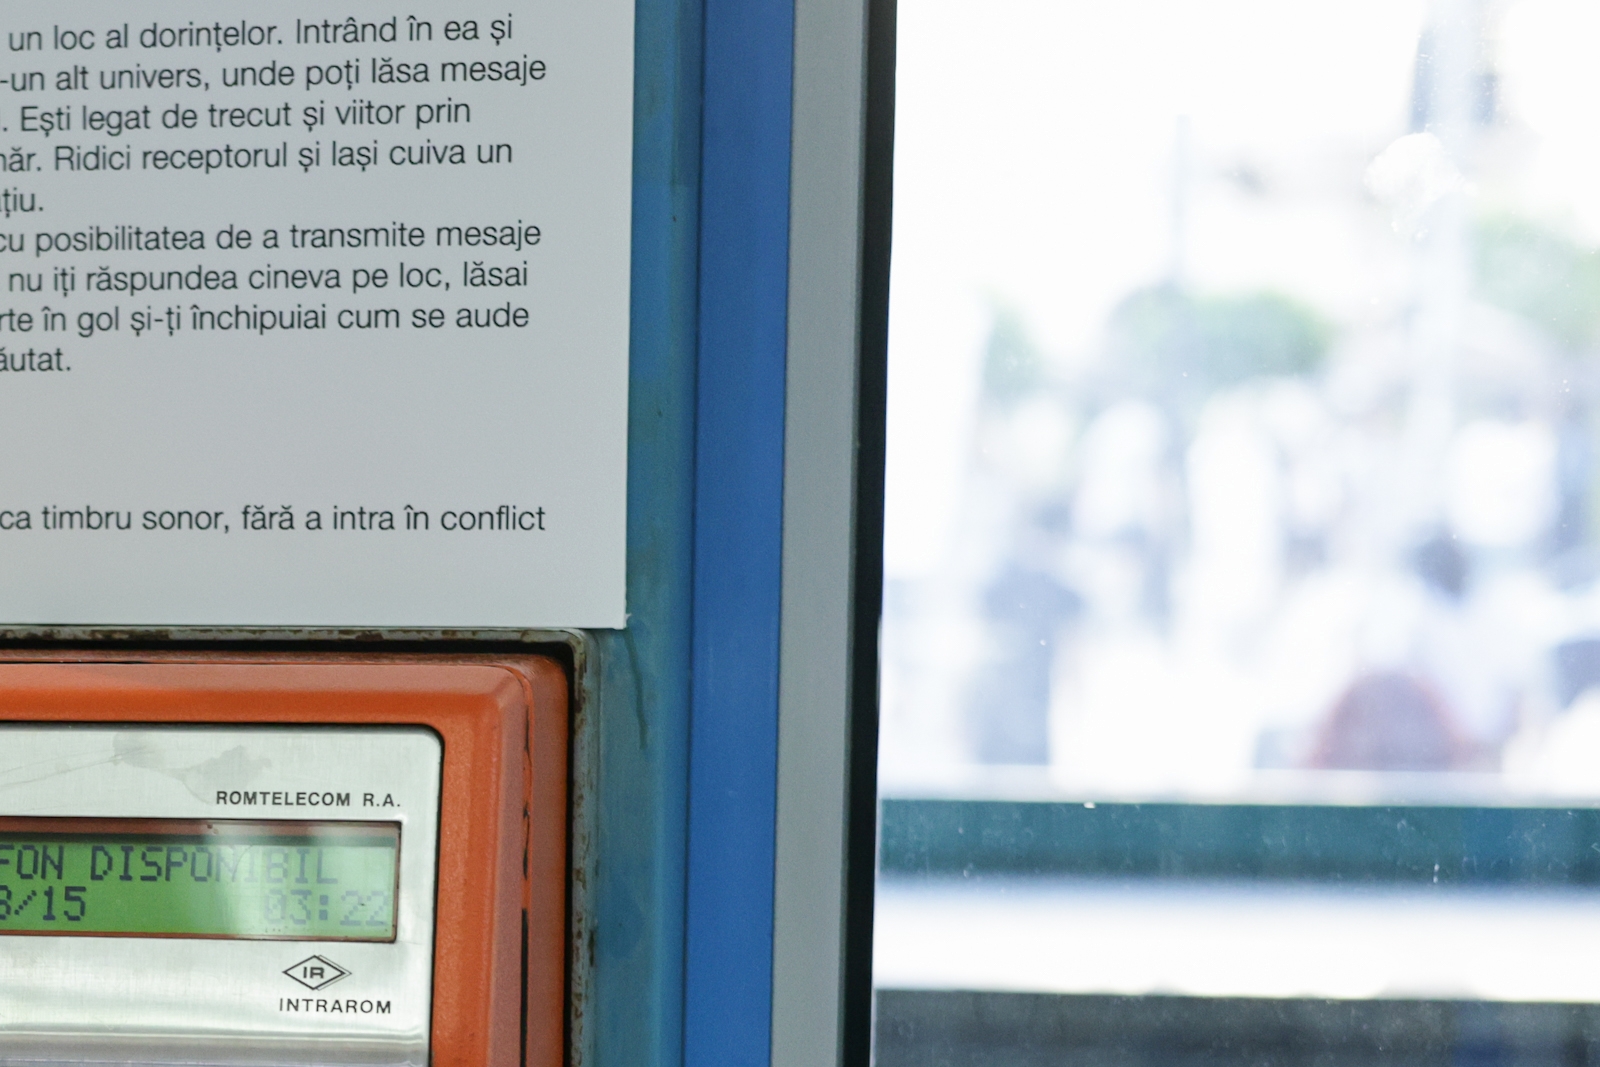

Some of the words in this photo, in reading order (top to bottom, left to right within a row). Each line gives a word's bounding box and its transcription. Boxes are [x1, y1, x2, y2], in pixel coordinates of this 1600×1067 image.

[8, 30, 43, 53] un
[53, 24, 96, 51] loc
[104, 22, 129, 50] al
[138, 19, 283, 54] dorințelor.
[296, 15, 398, 45] Intrând
[405, 14, 433, 42] în
[443, 19, 481, 42] ea
[489, 12, 513, 47] și
[54, 64, 90, 92] alt
[99, 62, 210, 92] univers,
[221, 59, 296, 88] unde
[305, 57, 361, 92] poți
[371, 56, 431, 85] lăsa
[440, 53, 547, 87] mesaje
[20, 104, 72, 139] Ești
[81, 104, 152, 138] legat
[160, 102, 199, 130] de
[206, 101, 293, 129] trecut
[302, 99, 325, 134] și
[334, 98, 407, 126] viitor
[415, 96, 471, 131] prin
[54, 143, 131, 172] Ridici
[141, 140, 288, 175] receptorul
[297, 140, 321, 174] și
[331, 139, 379, 173] lași
[388, 137, 467, 167] cuiva
[476, 142, 513, 165] un
[34, 224, 207, 259] posibilitatea
[215, 223, 253, 251] de
[261, 228, 281, 250] a
[288, 220, 426, 249] transmite
[435, 218, 542, 252] mesaje
[8, 272, 43, 293] nu
[85, 263, 239, 298] răspundea
[247, 263, 342, 291] cineva
[352, 267, 390, 295] pe
[399, 261, 451, 292] loc,
[462, 259, 528, 288] lăsai
[40, 305, 67, 332] în
[76, 305, 120, 339] gol
[129, 304, 182, 338] și-ți
[189, 302, 327, 337] închipuiai
[336, 308, 401, 330] cum
[410, 307, 446, 329] se
[455, 300, 530, 329] aude
[40, 504, 132, 531] timbru
[141, 509, 230, 535] sonor,
[240, 504, 296, 531] fără
[304, 509, 324, 531] a
[332, 504, 396, 532] intra
[402, 503, 430, 531] în
[439, 504, 547, 532] conflict
[216, 790, 351, 807] ROMTELECOM
[362, 793, 401, 807] R.A.
[90, 845, 339, 884] DISPONIBIL
[263, 888, 389, 926] 03:22
[302, 966, 325, 979] IR
[279, 997, 392, 1014] INTRAROM
